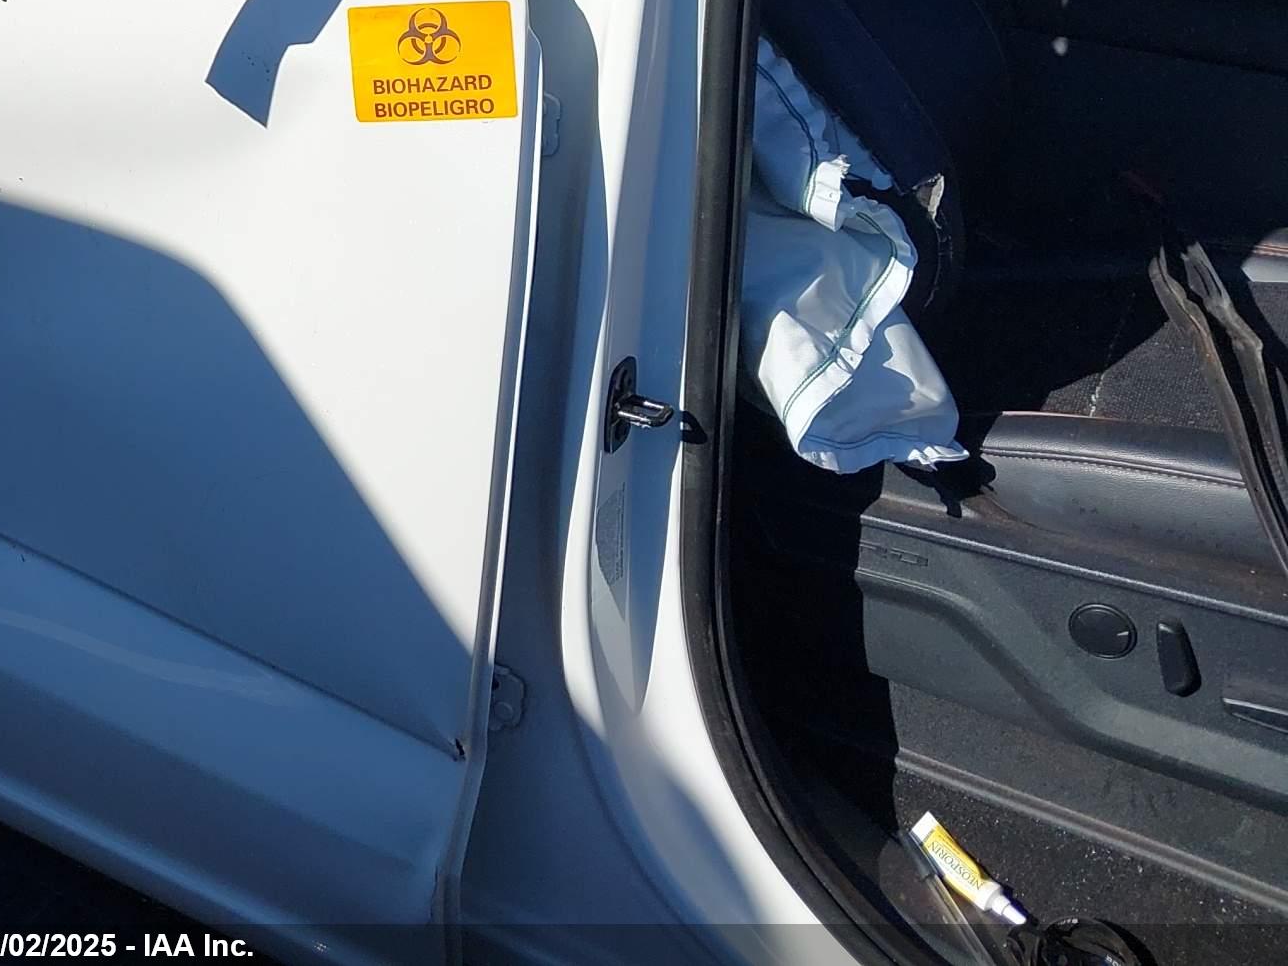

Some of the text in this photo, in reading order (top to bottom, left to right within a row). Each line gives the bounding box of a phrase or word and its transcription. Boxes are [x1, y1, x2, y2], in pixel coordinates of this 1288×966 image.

[372, 74, 493, 95] BIOHAZARD
[374, 98, 495, 118] BIOPELIGRO
[928, 841, 984, 891] NEOSPORIN
